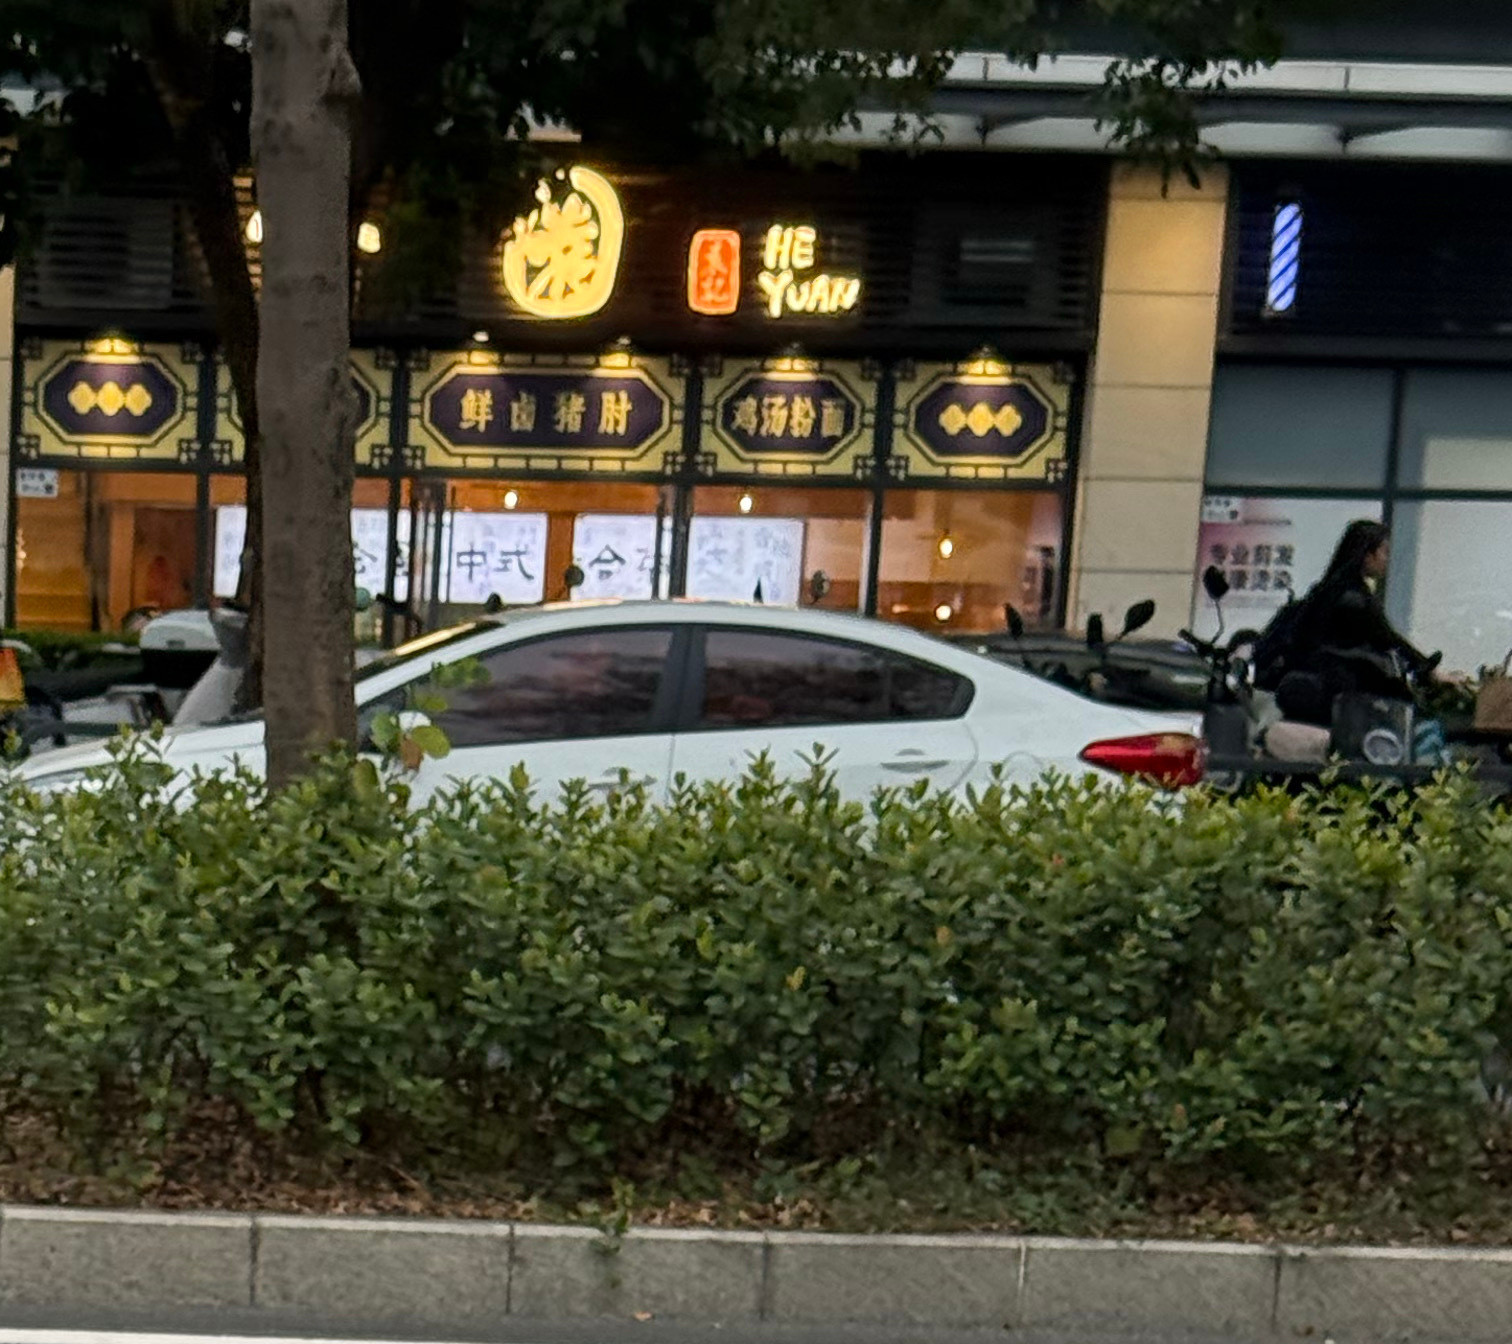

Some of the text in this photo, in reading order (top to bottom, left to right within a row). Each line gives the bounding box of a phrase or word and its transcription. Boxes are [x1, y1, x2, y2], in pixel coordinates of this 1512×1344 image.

[763, 224, 816, 270] HE
[457, 388, 633, 437] 鲜卤猪肘
[455, 543, 535, 583] 中式
